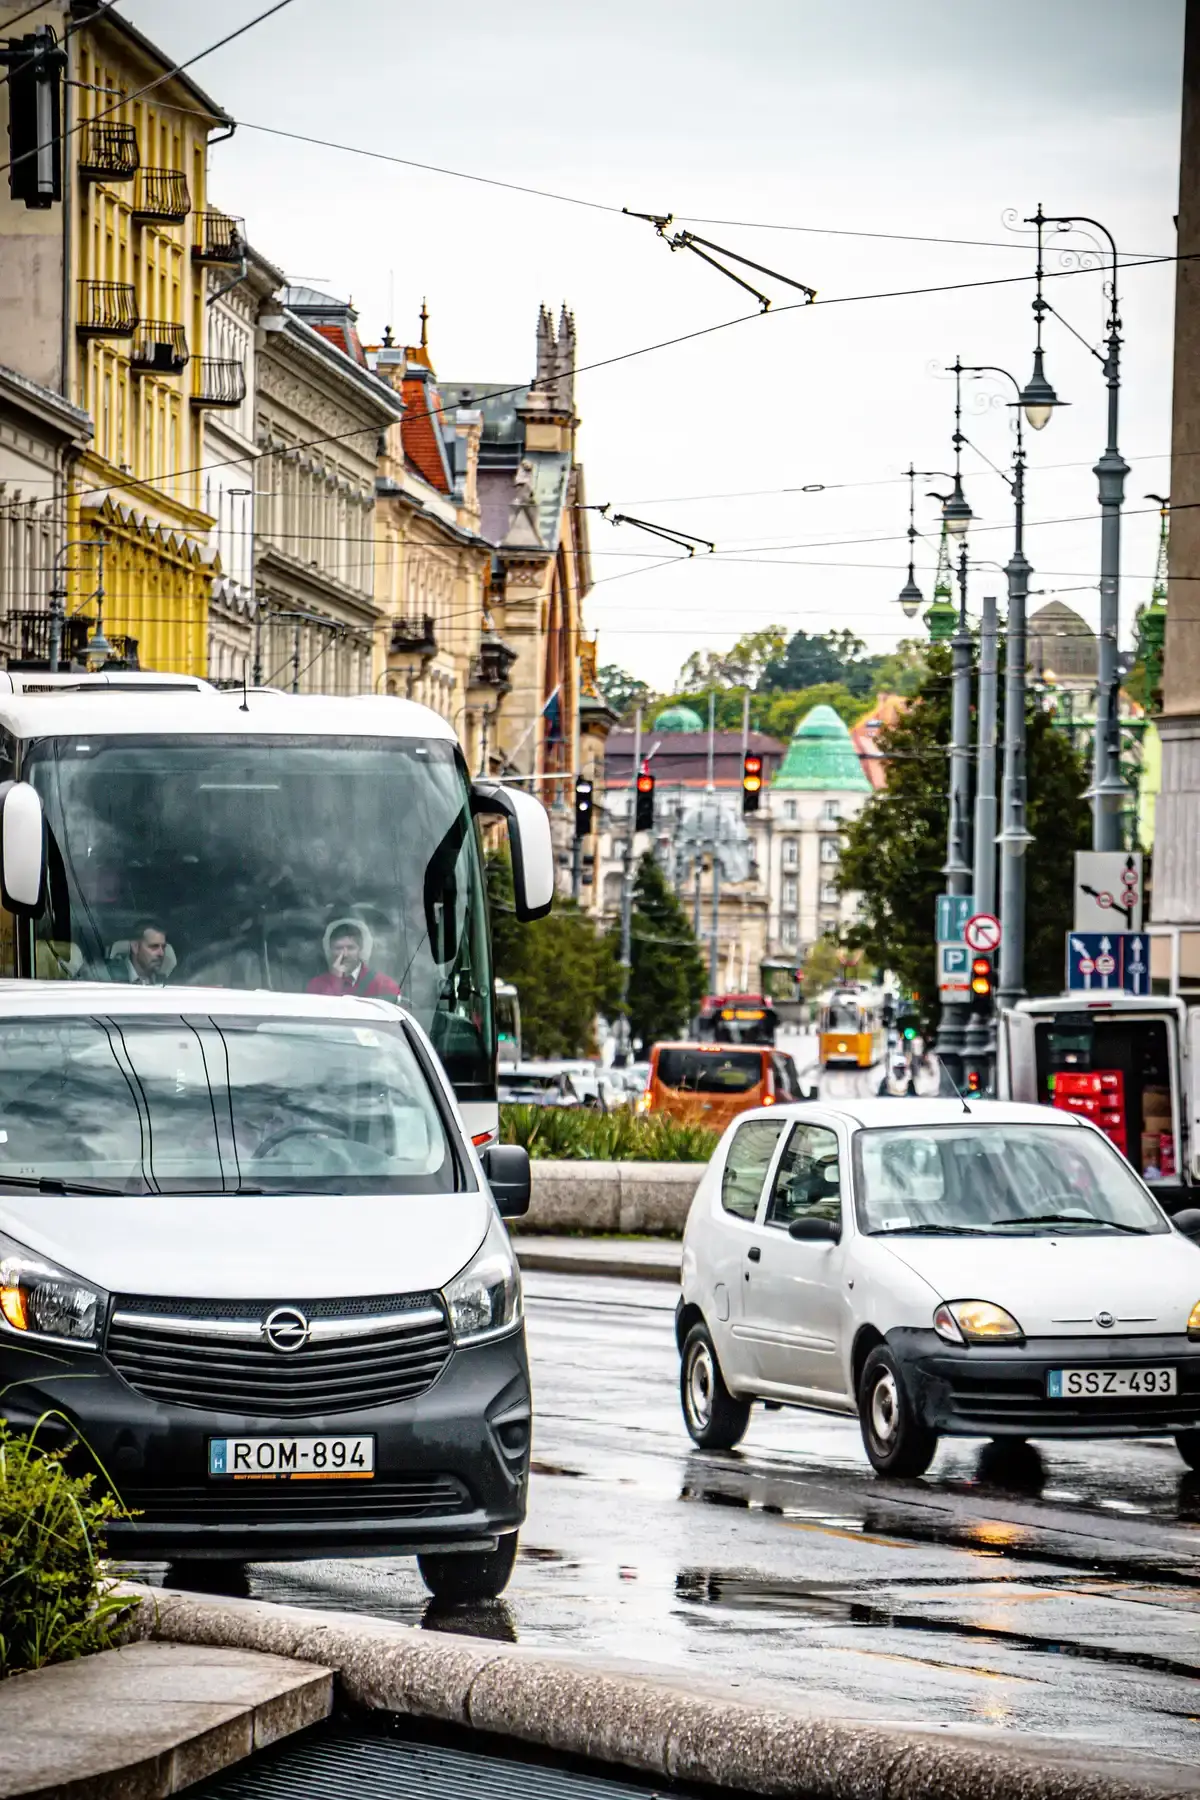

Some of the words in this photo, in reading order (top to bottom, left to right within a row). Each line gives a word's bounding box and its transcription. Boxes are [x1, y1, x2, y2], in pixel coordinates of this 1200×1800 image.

[947, 951, 965, 970] P
[1067, 1371, 1171, 1394] SSZ-493
[214, 1459, 223, 1469] H
[233, 1441, 365, 1469] ROM-894
